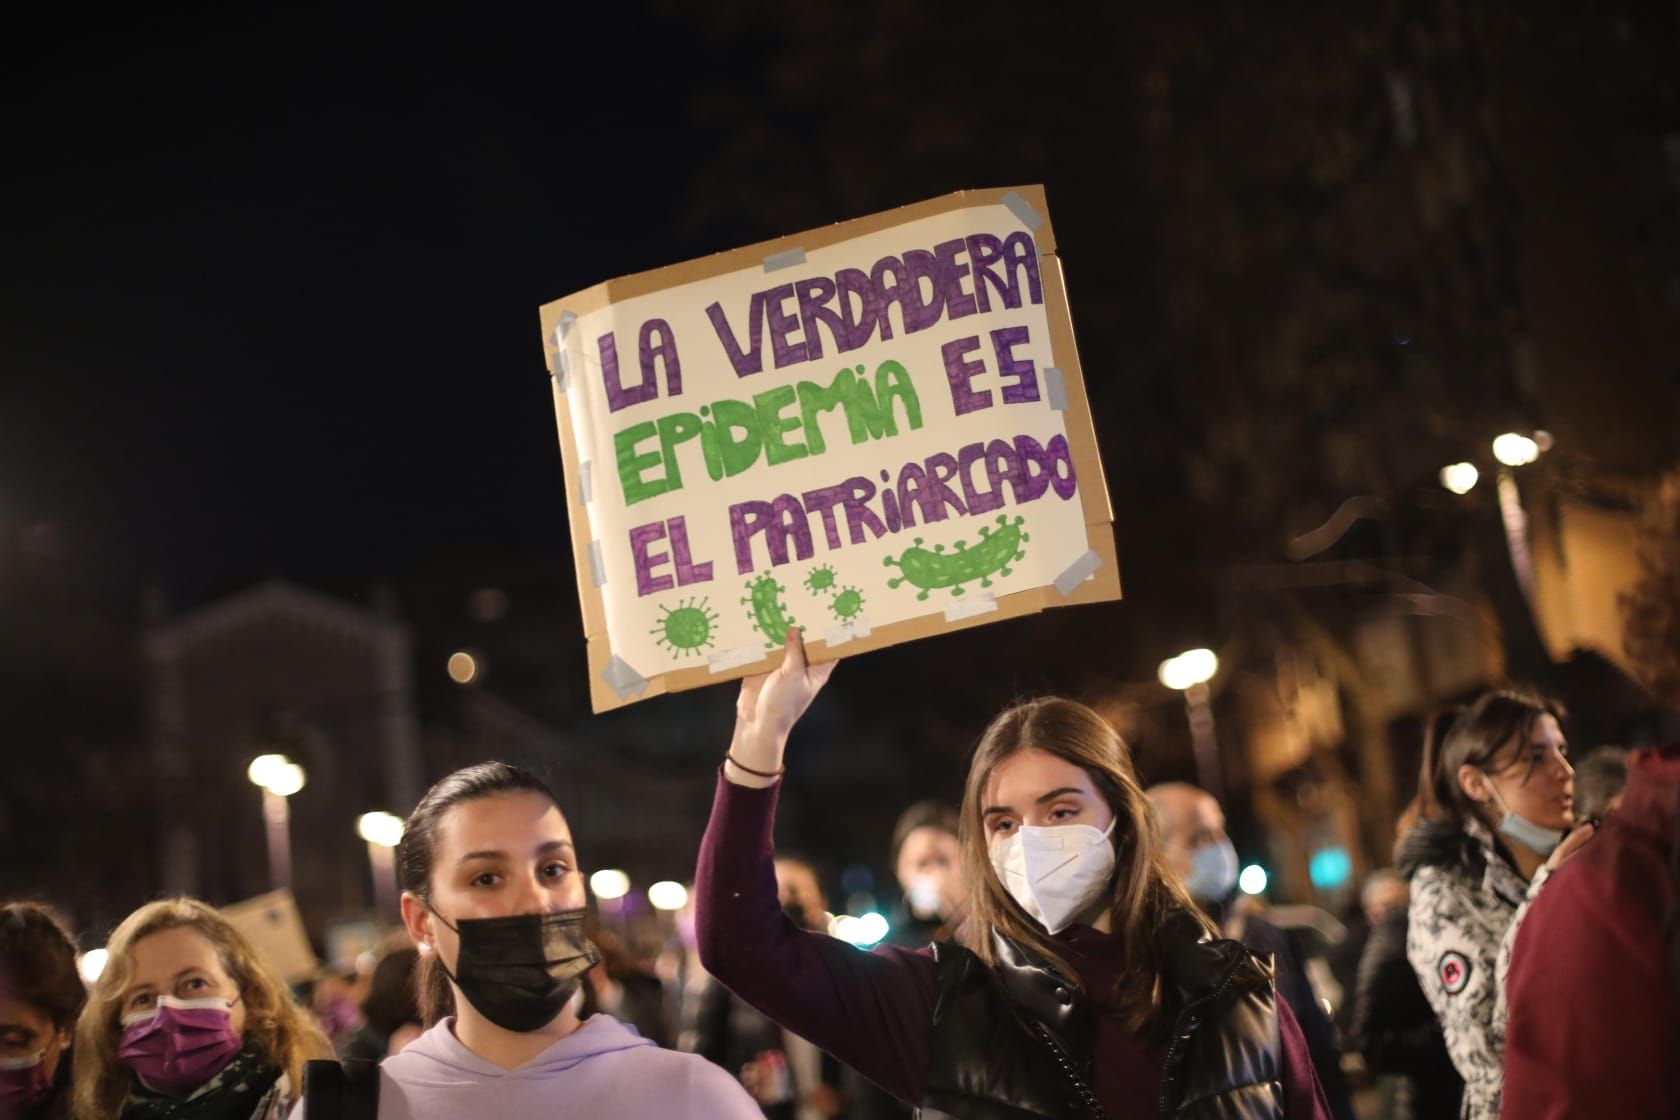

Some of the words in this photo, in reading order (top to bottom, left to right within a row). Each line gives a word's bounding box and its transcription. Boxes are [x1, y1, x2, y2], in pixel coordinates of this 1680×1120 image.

[597, 318, 683, 413] LA
[705, 232, 1043, 378] VERDADERA
[941, 326, 1041, 416] ES
[629, 516, 713, 597] EL
